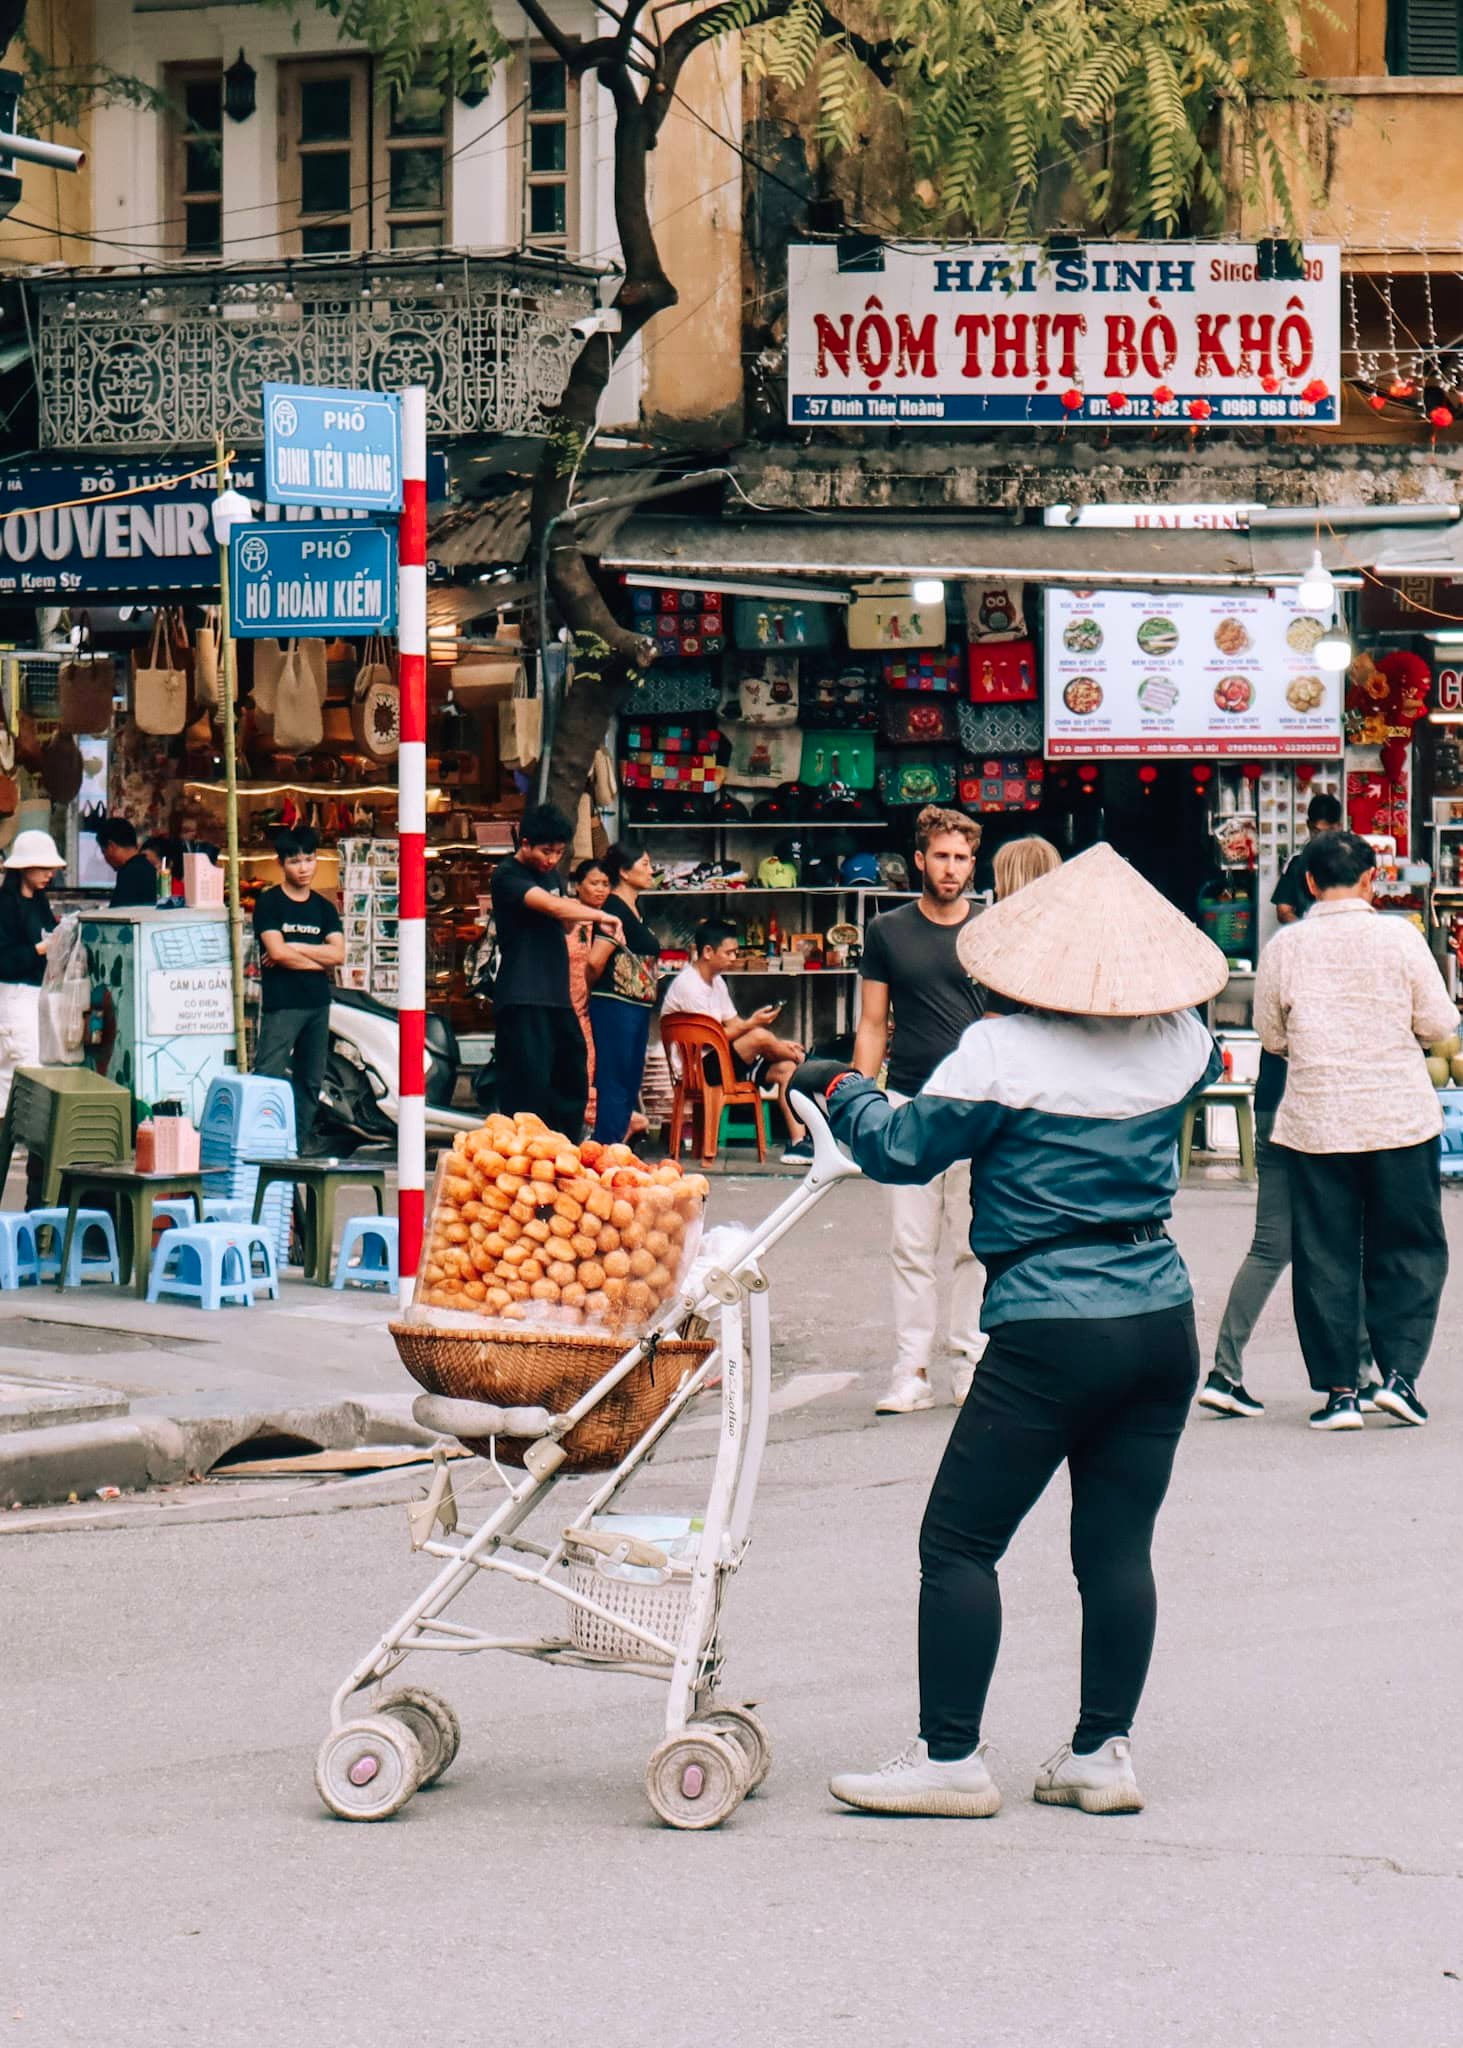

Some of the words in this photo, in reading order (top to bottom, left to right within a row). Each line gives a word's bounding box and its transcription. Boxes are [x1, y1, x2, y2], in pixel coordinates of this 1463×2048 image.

[1055, 258, 1195, 292] SINH
[813, 294, 938, 391] NỘM
[955, 313, 1088, 391] THỊT
[1104, 295, 1178, 379] BÒ
[1195, 294, 1313, 379] KHÔ
[323, 404, 366, 431] PHỐ
[900, 397, 944, 417] Hoàng
[80, 468, 116, 493] ĐỒ
[190, 471, 254, 489] NIM
[313, 442, 344, 489] TIÊN
[347, 445, 391, 492] HOÀNG
[0, 502, 212, 562] OUVENIR
[301, 531, 353, 560] PHỐ
[60, 571, 82, 588] Str
[245, 570, 273, 619] HỒ
[276, 572, 328, 618] HOÀN
[333, 567, 382, 618] KIẾM
